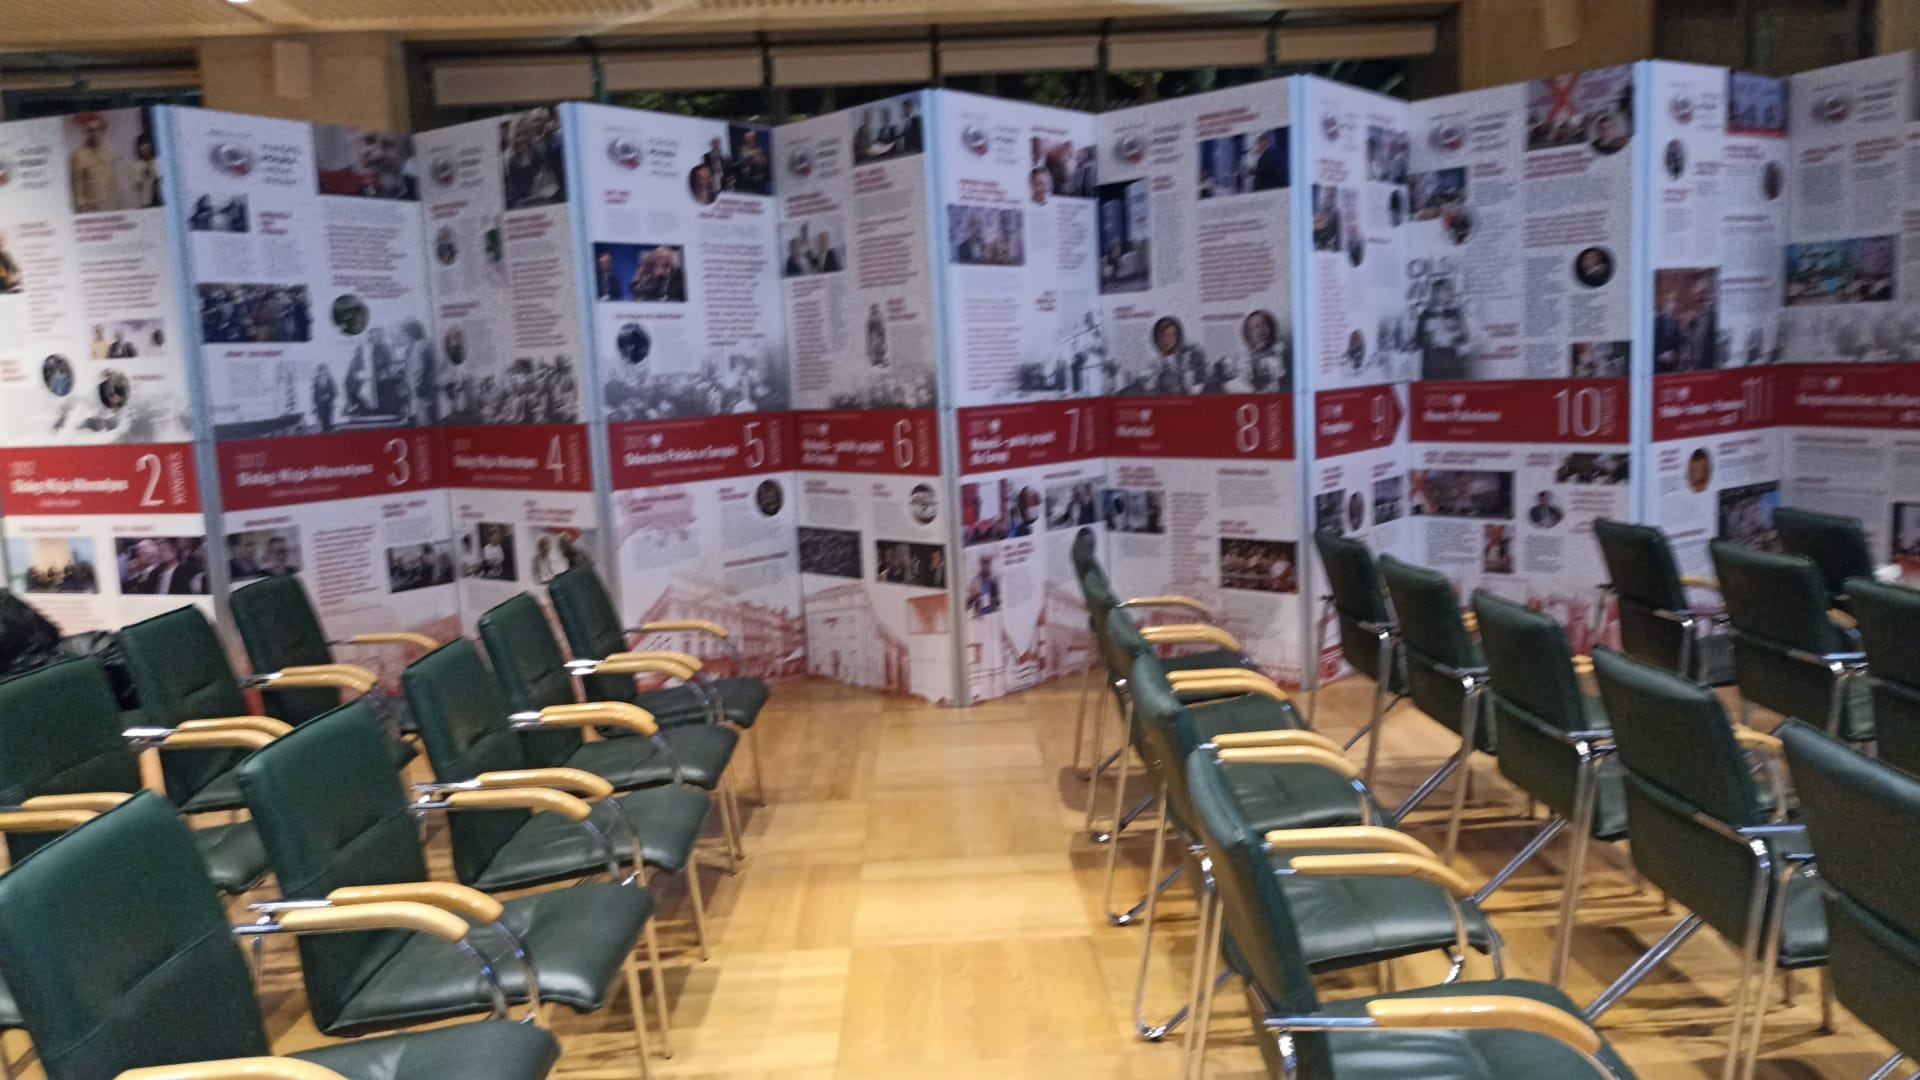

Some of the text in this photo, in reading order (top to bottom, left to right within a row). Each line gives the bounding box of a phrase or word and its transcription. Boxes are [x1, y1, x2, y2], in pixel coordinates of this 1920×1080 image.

[1064, 408, 1080, 454] 7
[1236, 403, 1260, 452] 8
[1371, 394, 1385, 441] 9
[1552, 387, 1600, 437] 10
[384, 437, 410, 487] 3
[545, 434, 566, 484] 4
[743, 422, 765, 468] 5
[893, 418, 914, 468] 6
[136, 453, 165, 507] 2
